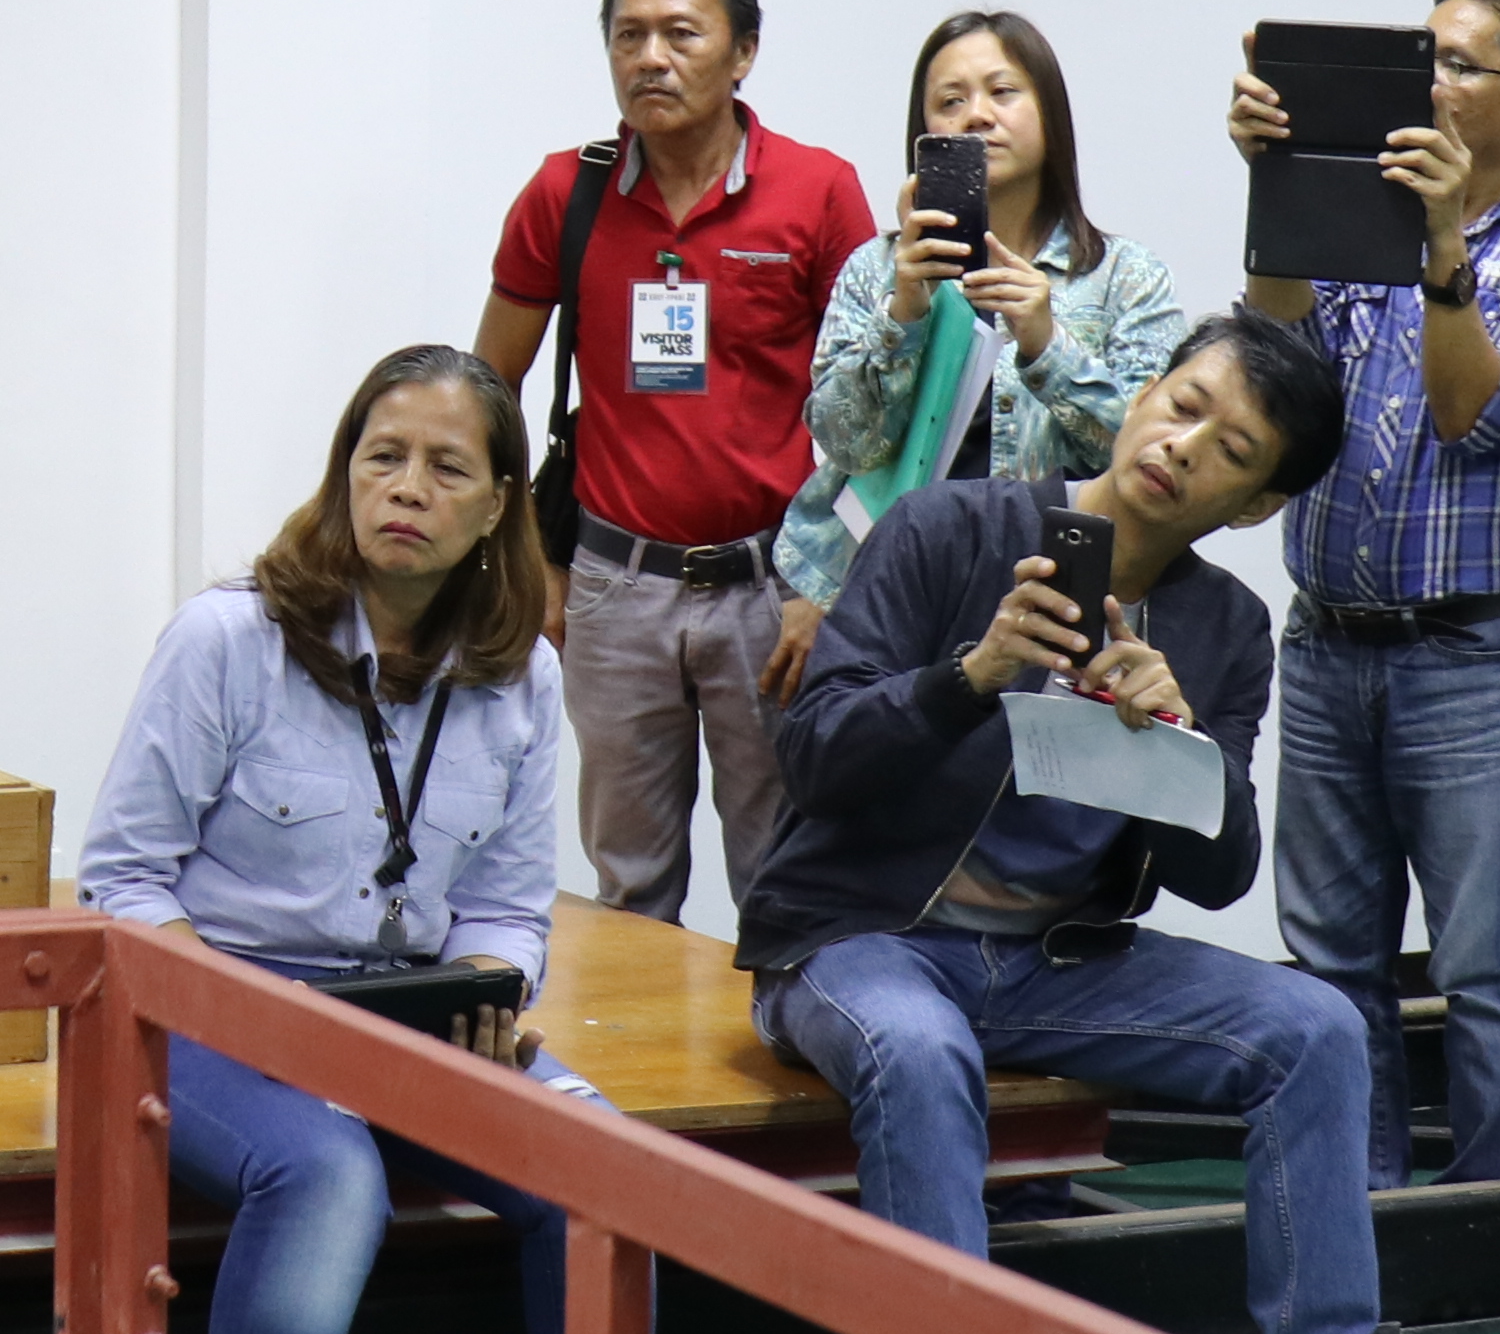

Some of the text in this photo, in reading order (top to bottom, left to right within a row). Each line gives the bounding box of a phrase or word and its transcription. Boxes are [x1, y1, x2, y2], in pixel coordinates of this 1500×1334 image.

[663, 305, 694, 331] 15
[640, 333, 693, 345] VISITOR
[660, 345, 693, 356] PASS
